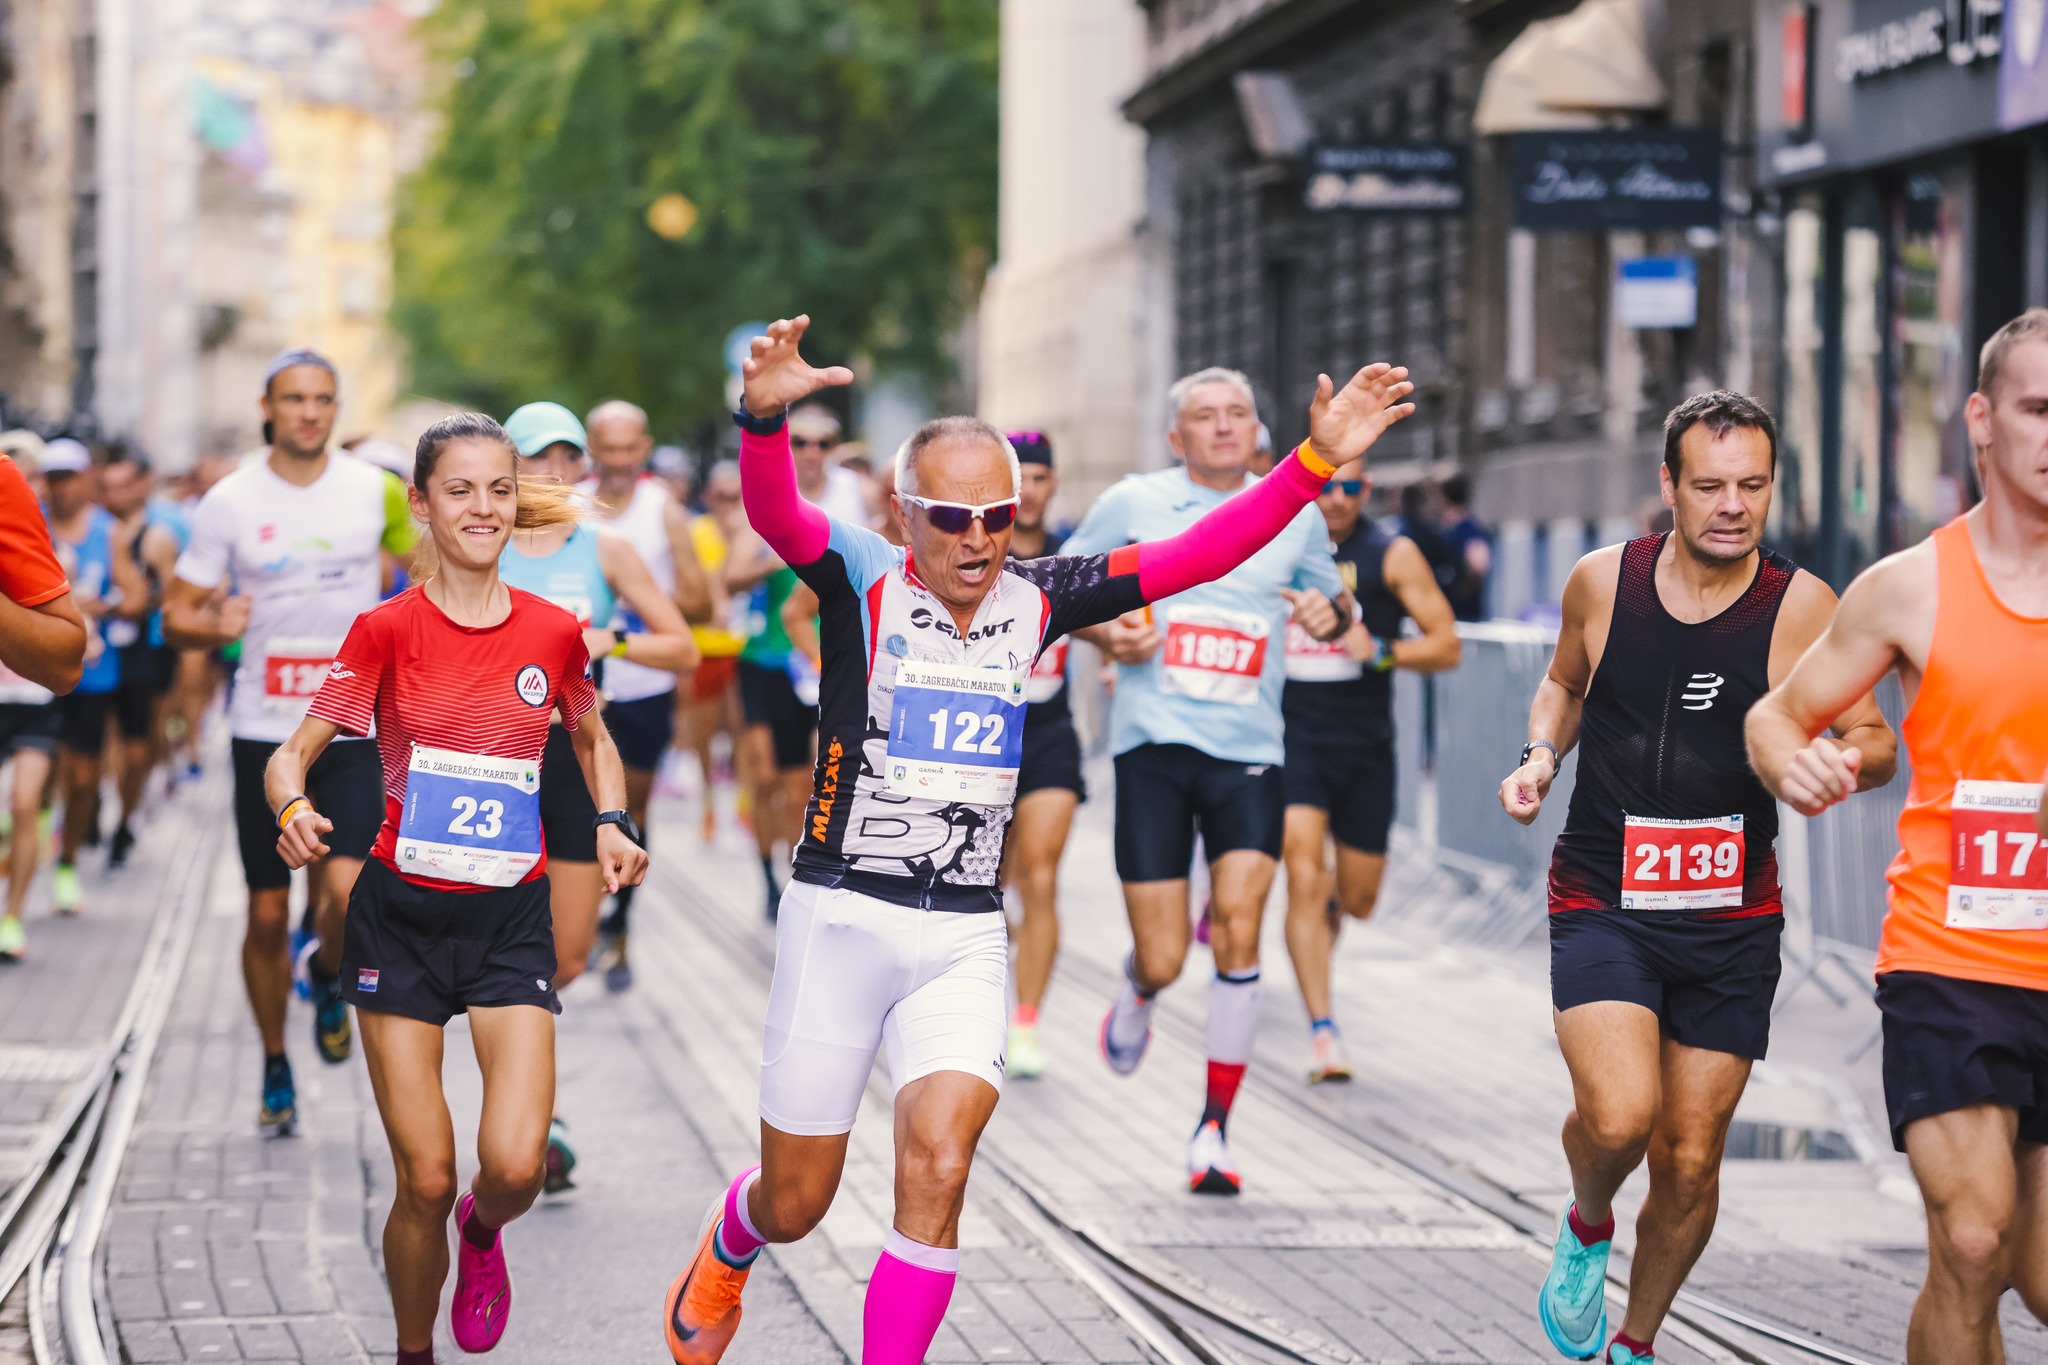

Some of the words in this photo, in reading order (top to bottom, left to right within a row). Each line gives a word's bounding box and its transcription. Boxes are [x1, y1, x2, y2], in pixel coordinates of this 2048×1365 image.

[1179, 632, 1255, 671] 1897
[904, 673, 918, 684] 30.
[921, 675, 970, 689] ZAGREBAČKI
[971, 682, 1007, 693] MARATON
[928, 708, 1005, 755] 122
[417, 759, 430, 770] 30.
[432, 762, 481, 776] ZAGREBAČKI
[482, 768, 519, 781] MARATON
[918, 767, 944, 775] GARMIN
[1962, 793, 1978, 805] 30.
[447, 796, 504, 838] 23
[1634, 841, 1739, 881] 2139
[1973, 829, 2048, 878] 17
[1644, 895, 1669, 903] GARMIN
